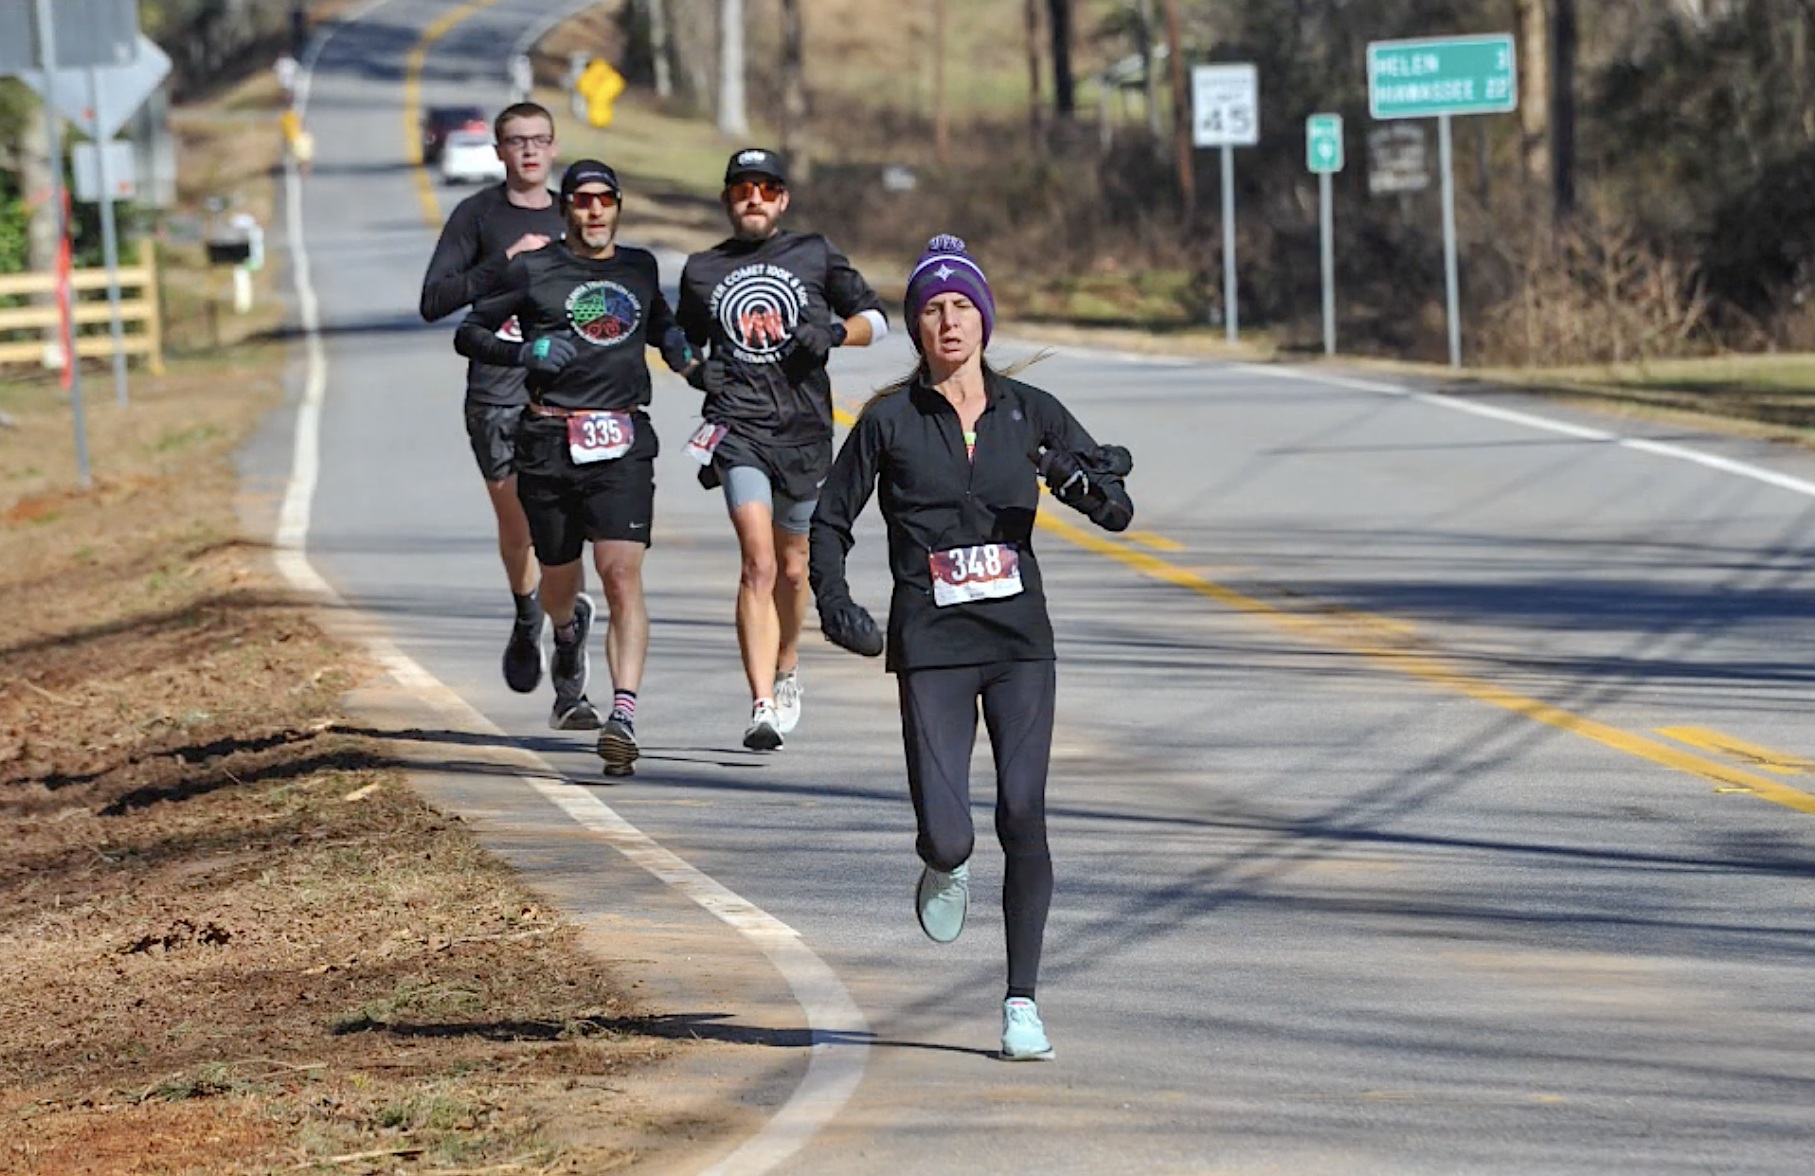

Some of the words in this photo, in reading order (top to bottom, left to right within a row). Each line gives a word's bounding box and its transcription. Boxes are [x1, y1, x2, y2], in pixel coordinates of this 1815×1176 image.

[1374, 53, 1439, 77] HELEN
[1202, 105, 1251, 136] 45
[723, 263, 765, 286] COMET
[582, 418, 623, 448] 335
[948, 543, 1002, 582] 348
